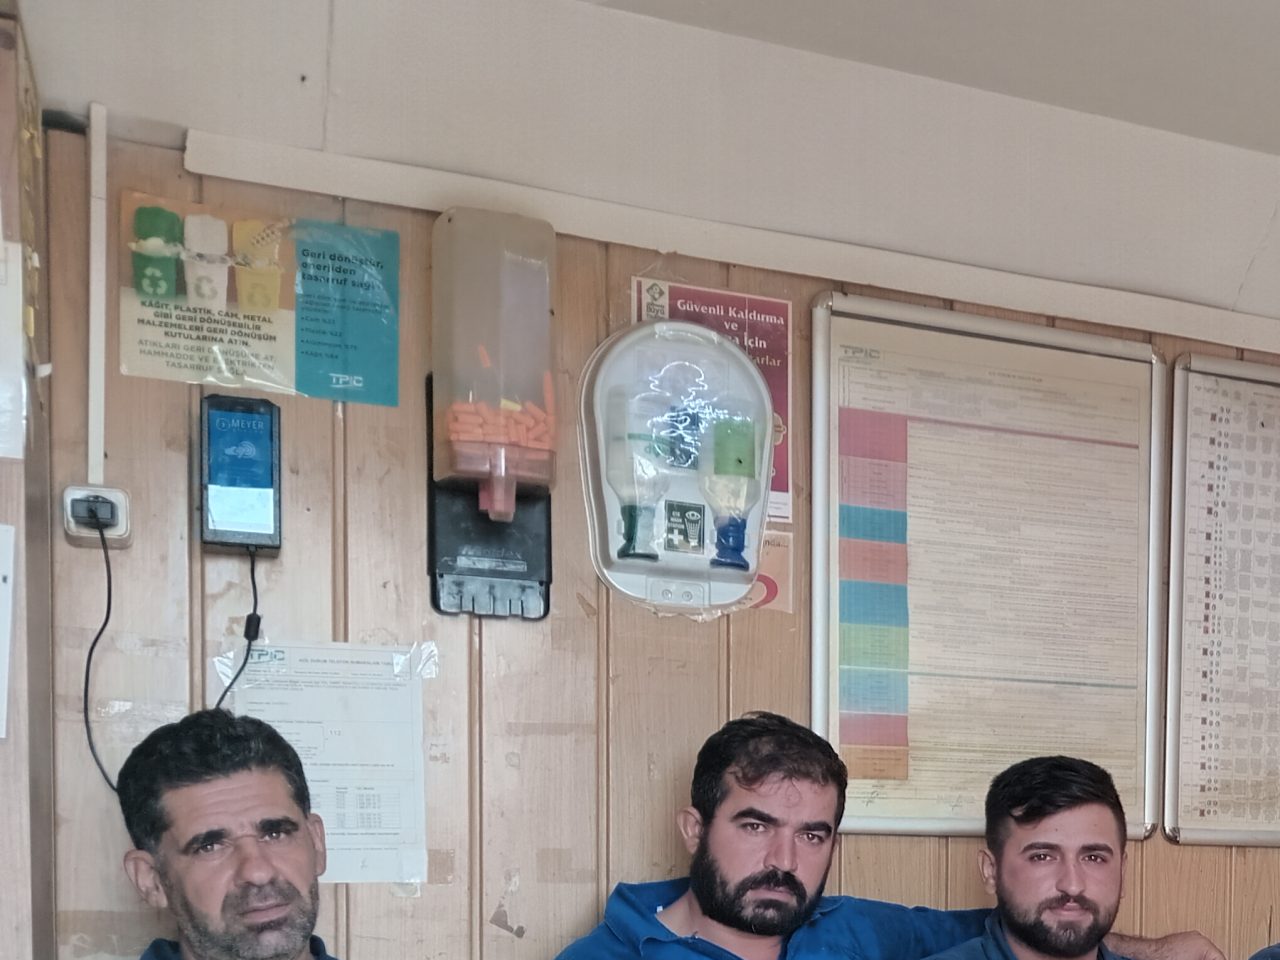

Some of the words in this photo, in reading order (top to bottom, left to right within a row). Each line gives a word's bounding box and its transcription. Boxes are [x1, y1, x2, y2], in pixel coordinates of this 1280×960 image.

[301, 249, 326, 260] Geri
[301, 272, 349, 286] tasarruf
[677, 299, 724, 316] Güvenli
[728, 307, 785, 325] Kaldırma
[175, 313, 197, 323] GERİ
[242, 313, 273, 324] METAL
[206, 325, 228, 335] GERİ
[724, 320, 738, 331] ve
[231, 418, 264, 429] MEYER
